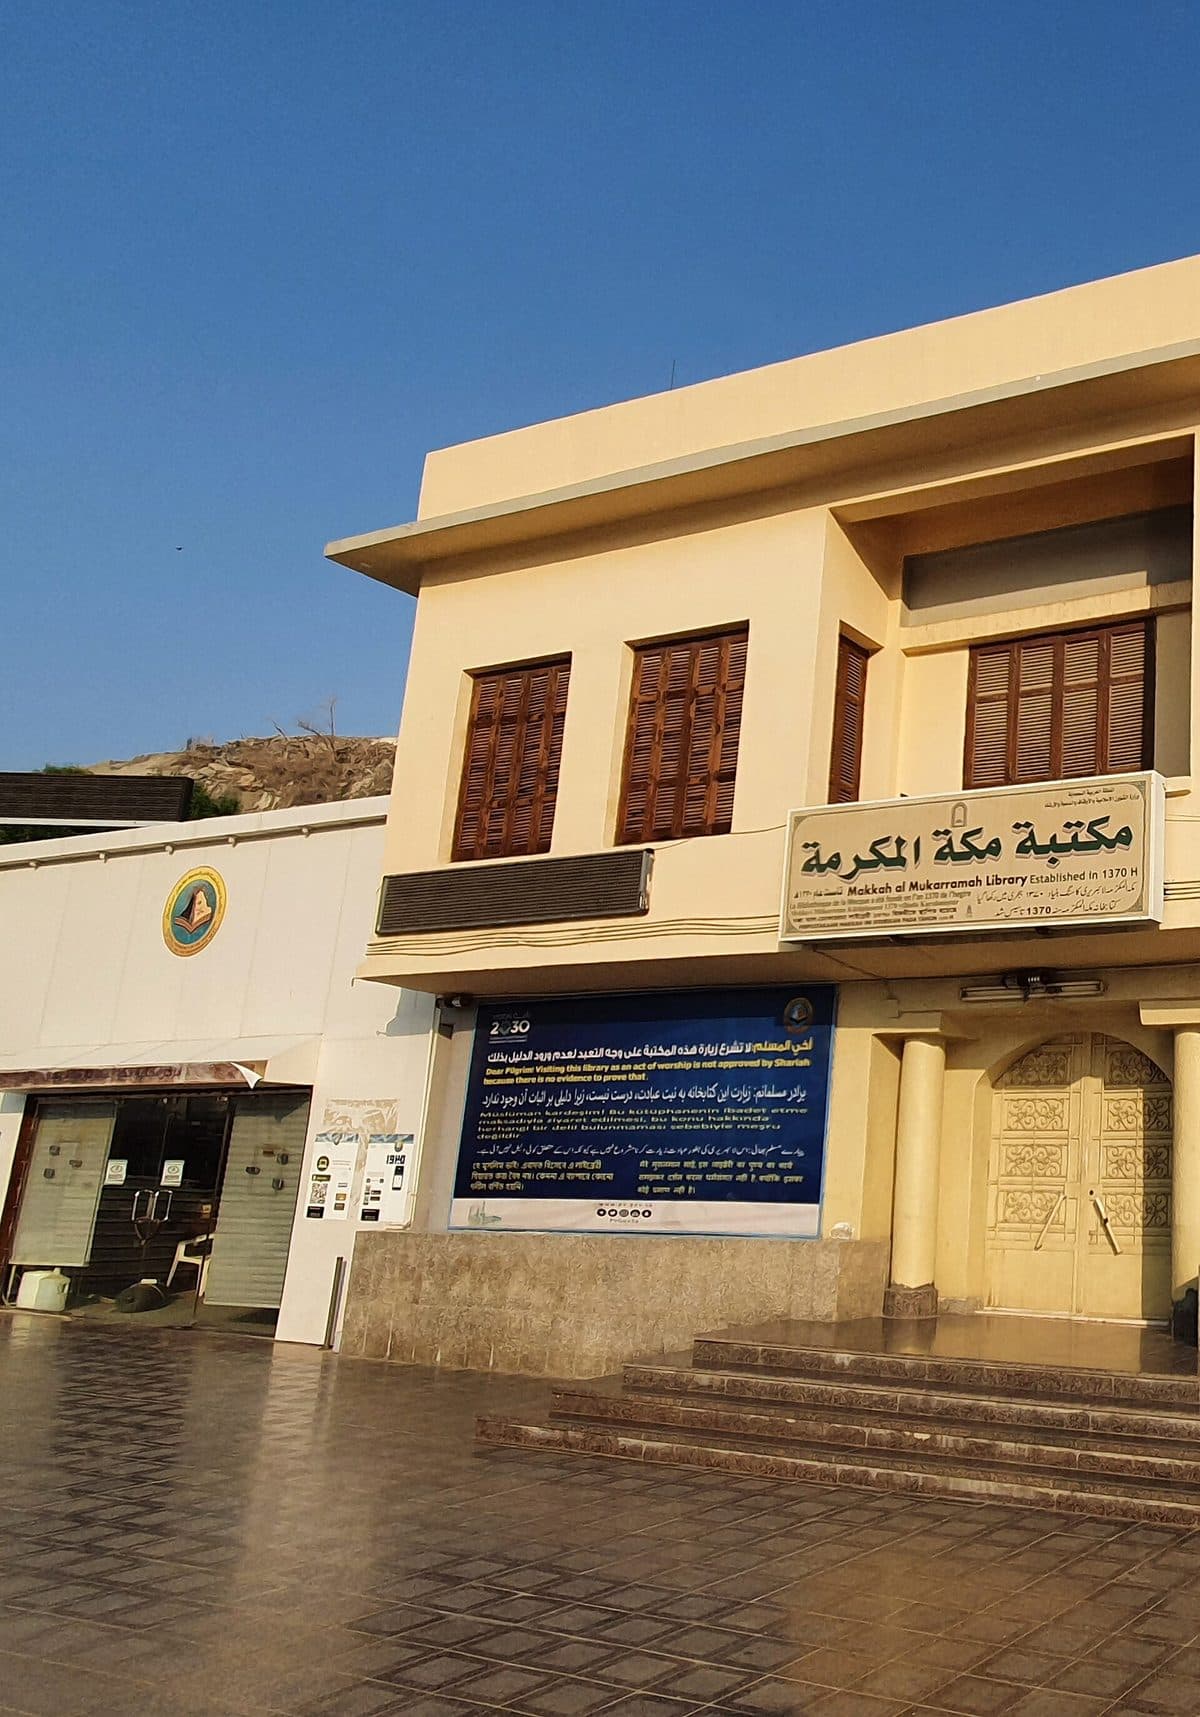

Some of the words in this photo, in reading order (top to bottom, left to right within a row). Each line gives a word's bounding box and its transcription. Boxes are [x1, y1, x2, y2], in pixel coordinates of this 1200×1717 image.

[932, 827, 1001, 862] مكة
[1012, 815, 1133, 865] مكتبة
[801, 835, 921, 881] المكرمة
[847, 882, 892, 896] Makkah
[895, 880, 906, 892] al
[909, 875, 983, 892] Mukarramah
[985, 873, 1028, 888] Library
[1030, 870, 1086, 884] Established
[1102, 867, 1128, 880] 1370
[1131, 866, 1138, 878] H
[1026, 905, 1052, 916] 1370
[624, 1045, 643, 1060] على
[643, 1043, 677, 1059] المكتبة
[677, 1041, 698, 1055] هذه
[698, 1042, 719, 1057] زيارة
[718, 1040, 743, 1057] تشرع
[792, 1036, 814, 1056] أخي
[487, 1050, 508, 1063] بذلك
[509, 1050, 533, 1064] الدليل
[533, 1052, 551, 1062] ورود
[552, 1048, 577, 1062] لعدم
[578, 1047, 604, 1060] التعبد
[605, 1048, 623, 1061] وجه
[535, 1064, 565, 1075] Visiting
[566, 1063, 581, 1073] this
[583, 1062, 609, 1073] library
[610, 1064, 620, 1072] as
[621, 1063, 632, 1071] an
[632, 1062, 646, 1071] act
[647, 1061, 657, 1070] of
[657, 1060, 691, 1071] worship
[693, 1060, 700, 1069] is
[702, 1060, 716, 1069] not
[718, 1059, 760, 1070] approved
[762, 1058, 773, 1069] by
[774, 1058, 811, 1067] Shariah
[515, 1075, 536, 1084] there
[537, 1075, 545, 1083] is
[556, 1074, 592, 1083] evidence
[593, 1073, 602, 1082] to
[603, 1074, 627, 1084] prove
[609, 1108, 625, 1116] Bu
[771, 1106, 808, 1114] etme
[551, 1123, 578, 1131] delil
[670, 1123, 733, 1131] sebebiyle
